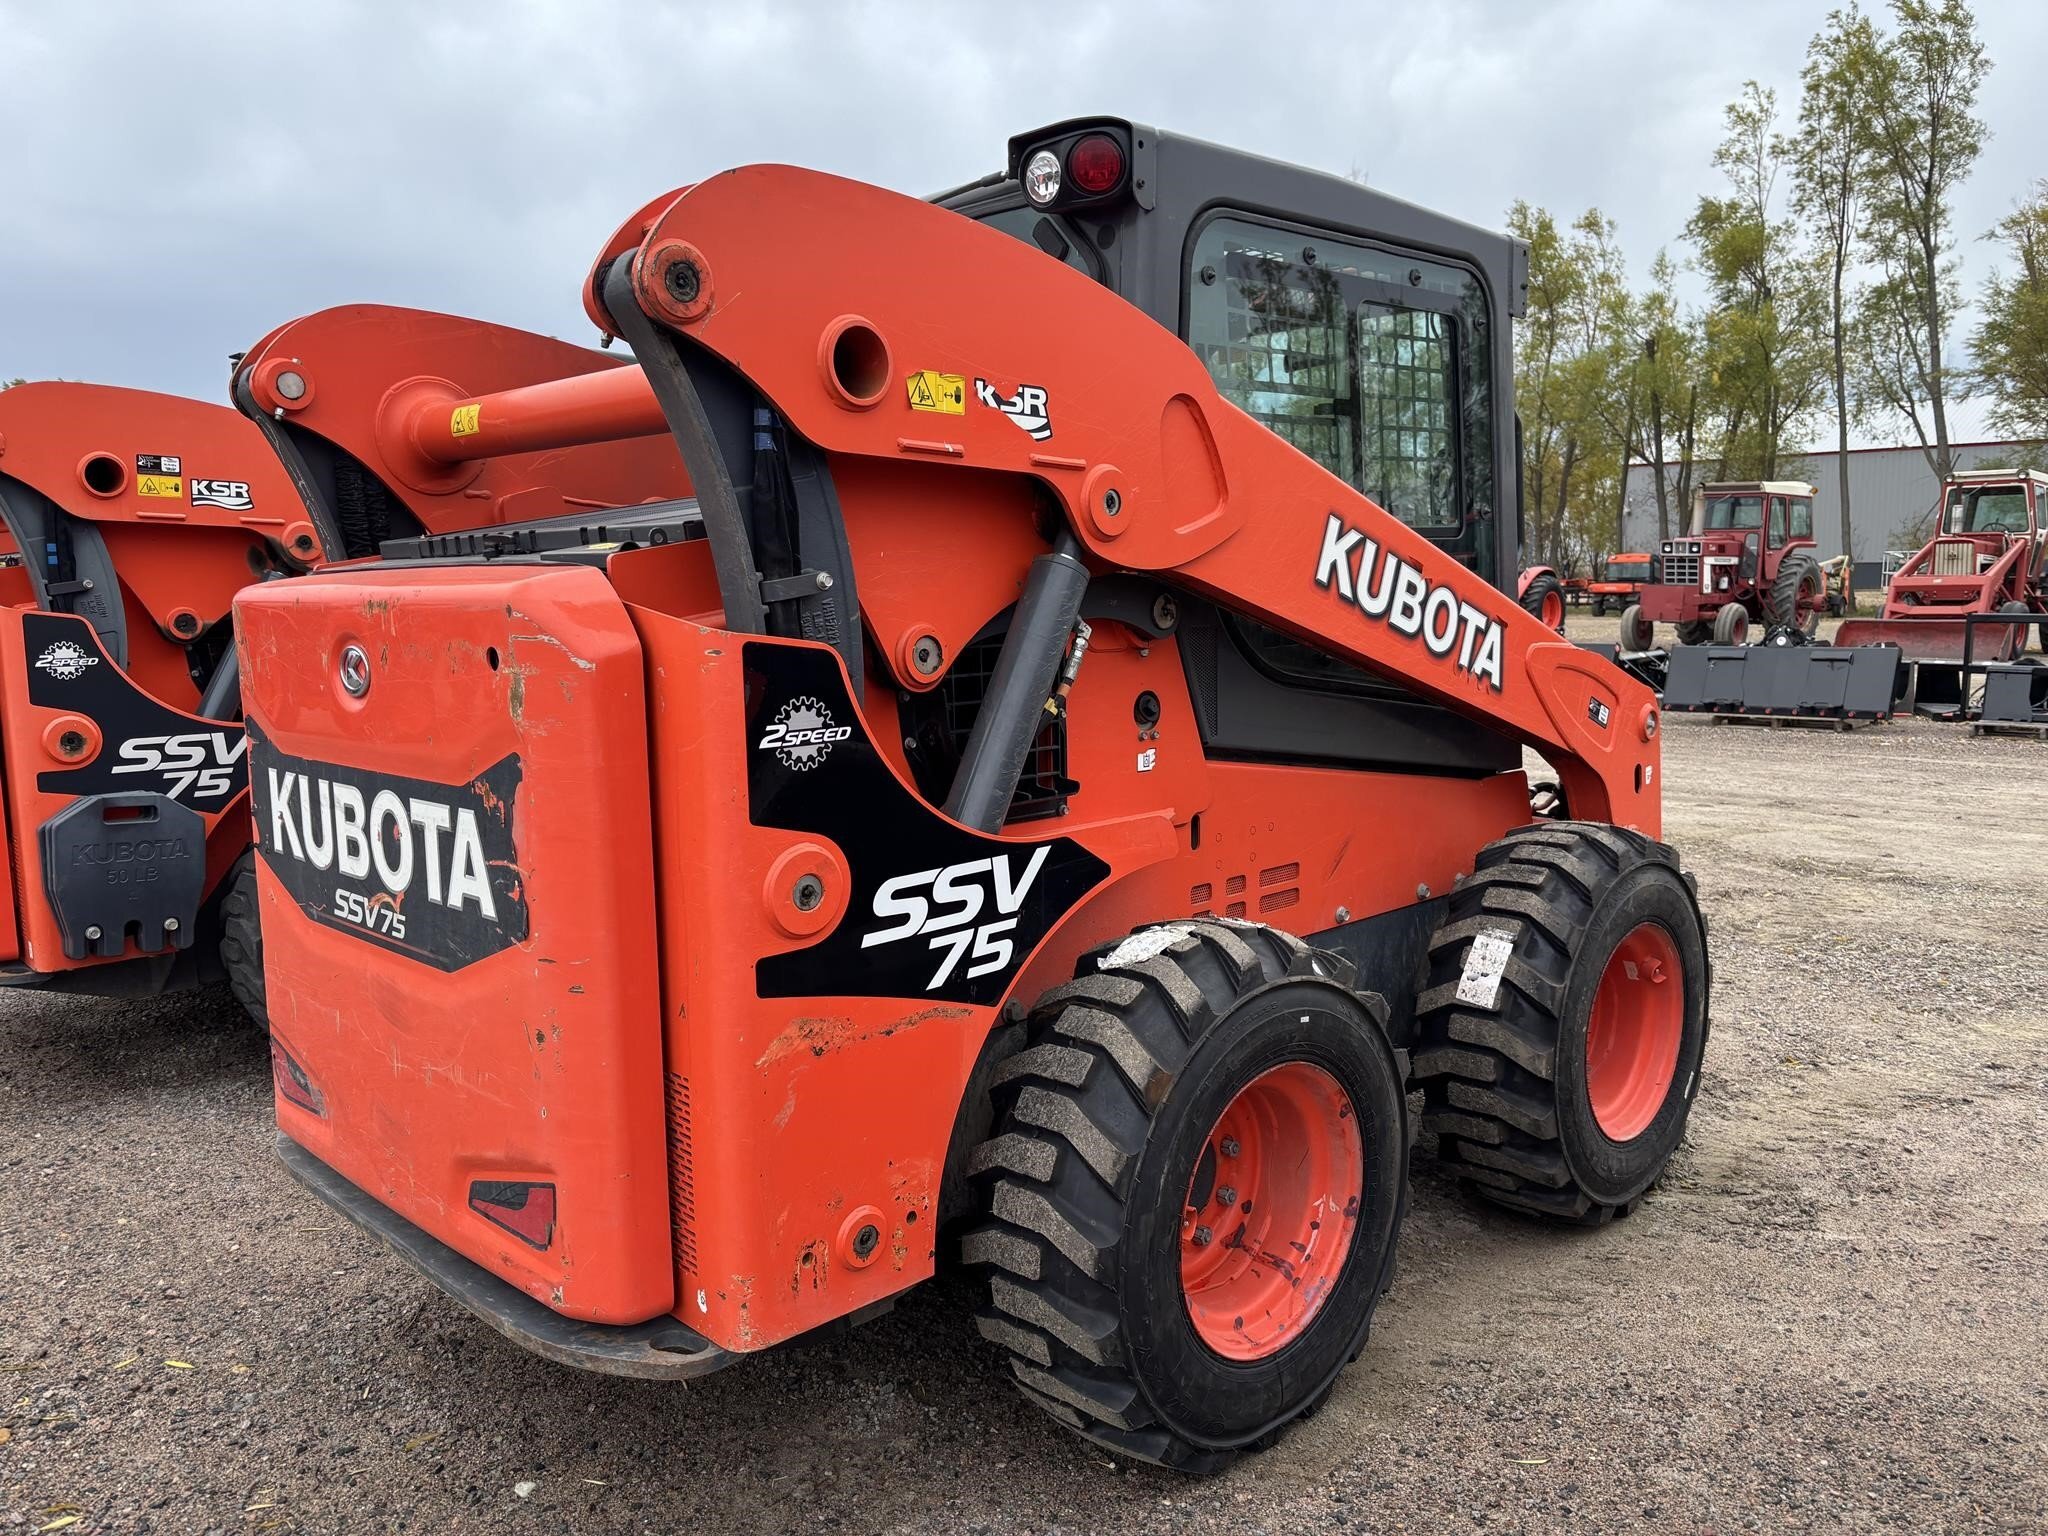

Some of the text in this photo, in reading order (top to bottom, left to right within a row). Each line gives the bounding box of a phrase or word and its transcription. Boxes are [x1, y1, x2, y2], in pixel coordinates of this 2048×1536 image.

[191, 479, 249, 498] KSR
[1315, 514, 1501, 689] KUBOTA
[111, 732, 249, 774] SSV
[163, 767, 234, 799] 75
[72, 838, 190, 866] KUBOTA
[268, 767, 499, 922] KUBOTA
[105, 867, 160, 884] 50 LB
[861, 846, 1052, 949] SSV
[926, 917, 1018, 991] 75
